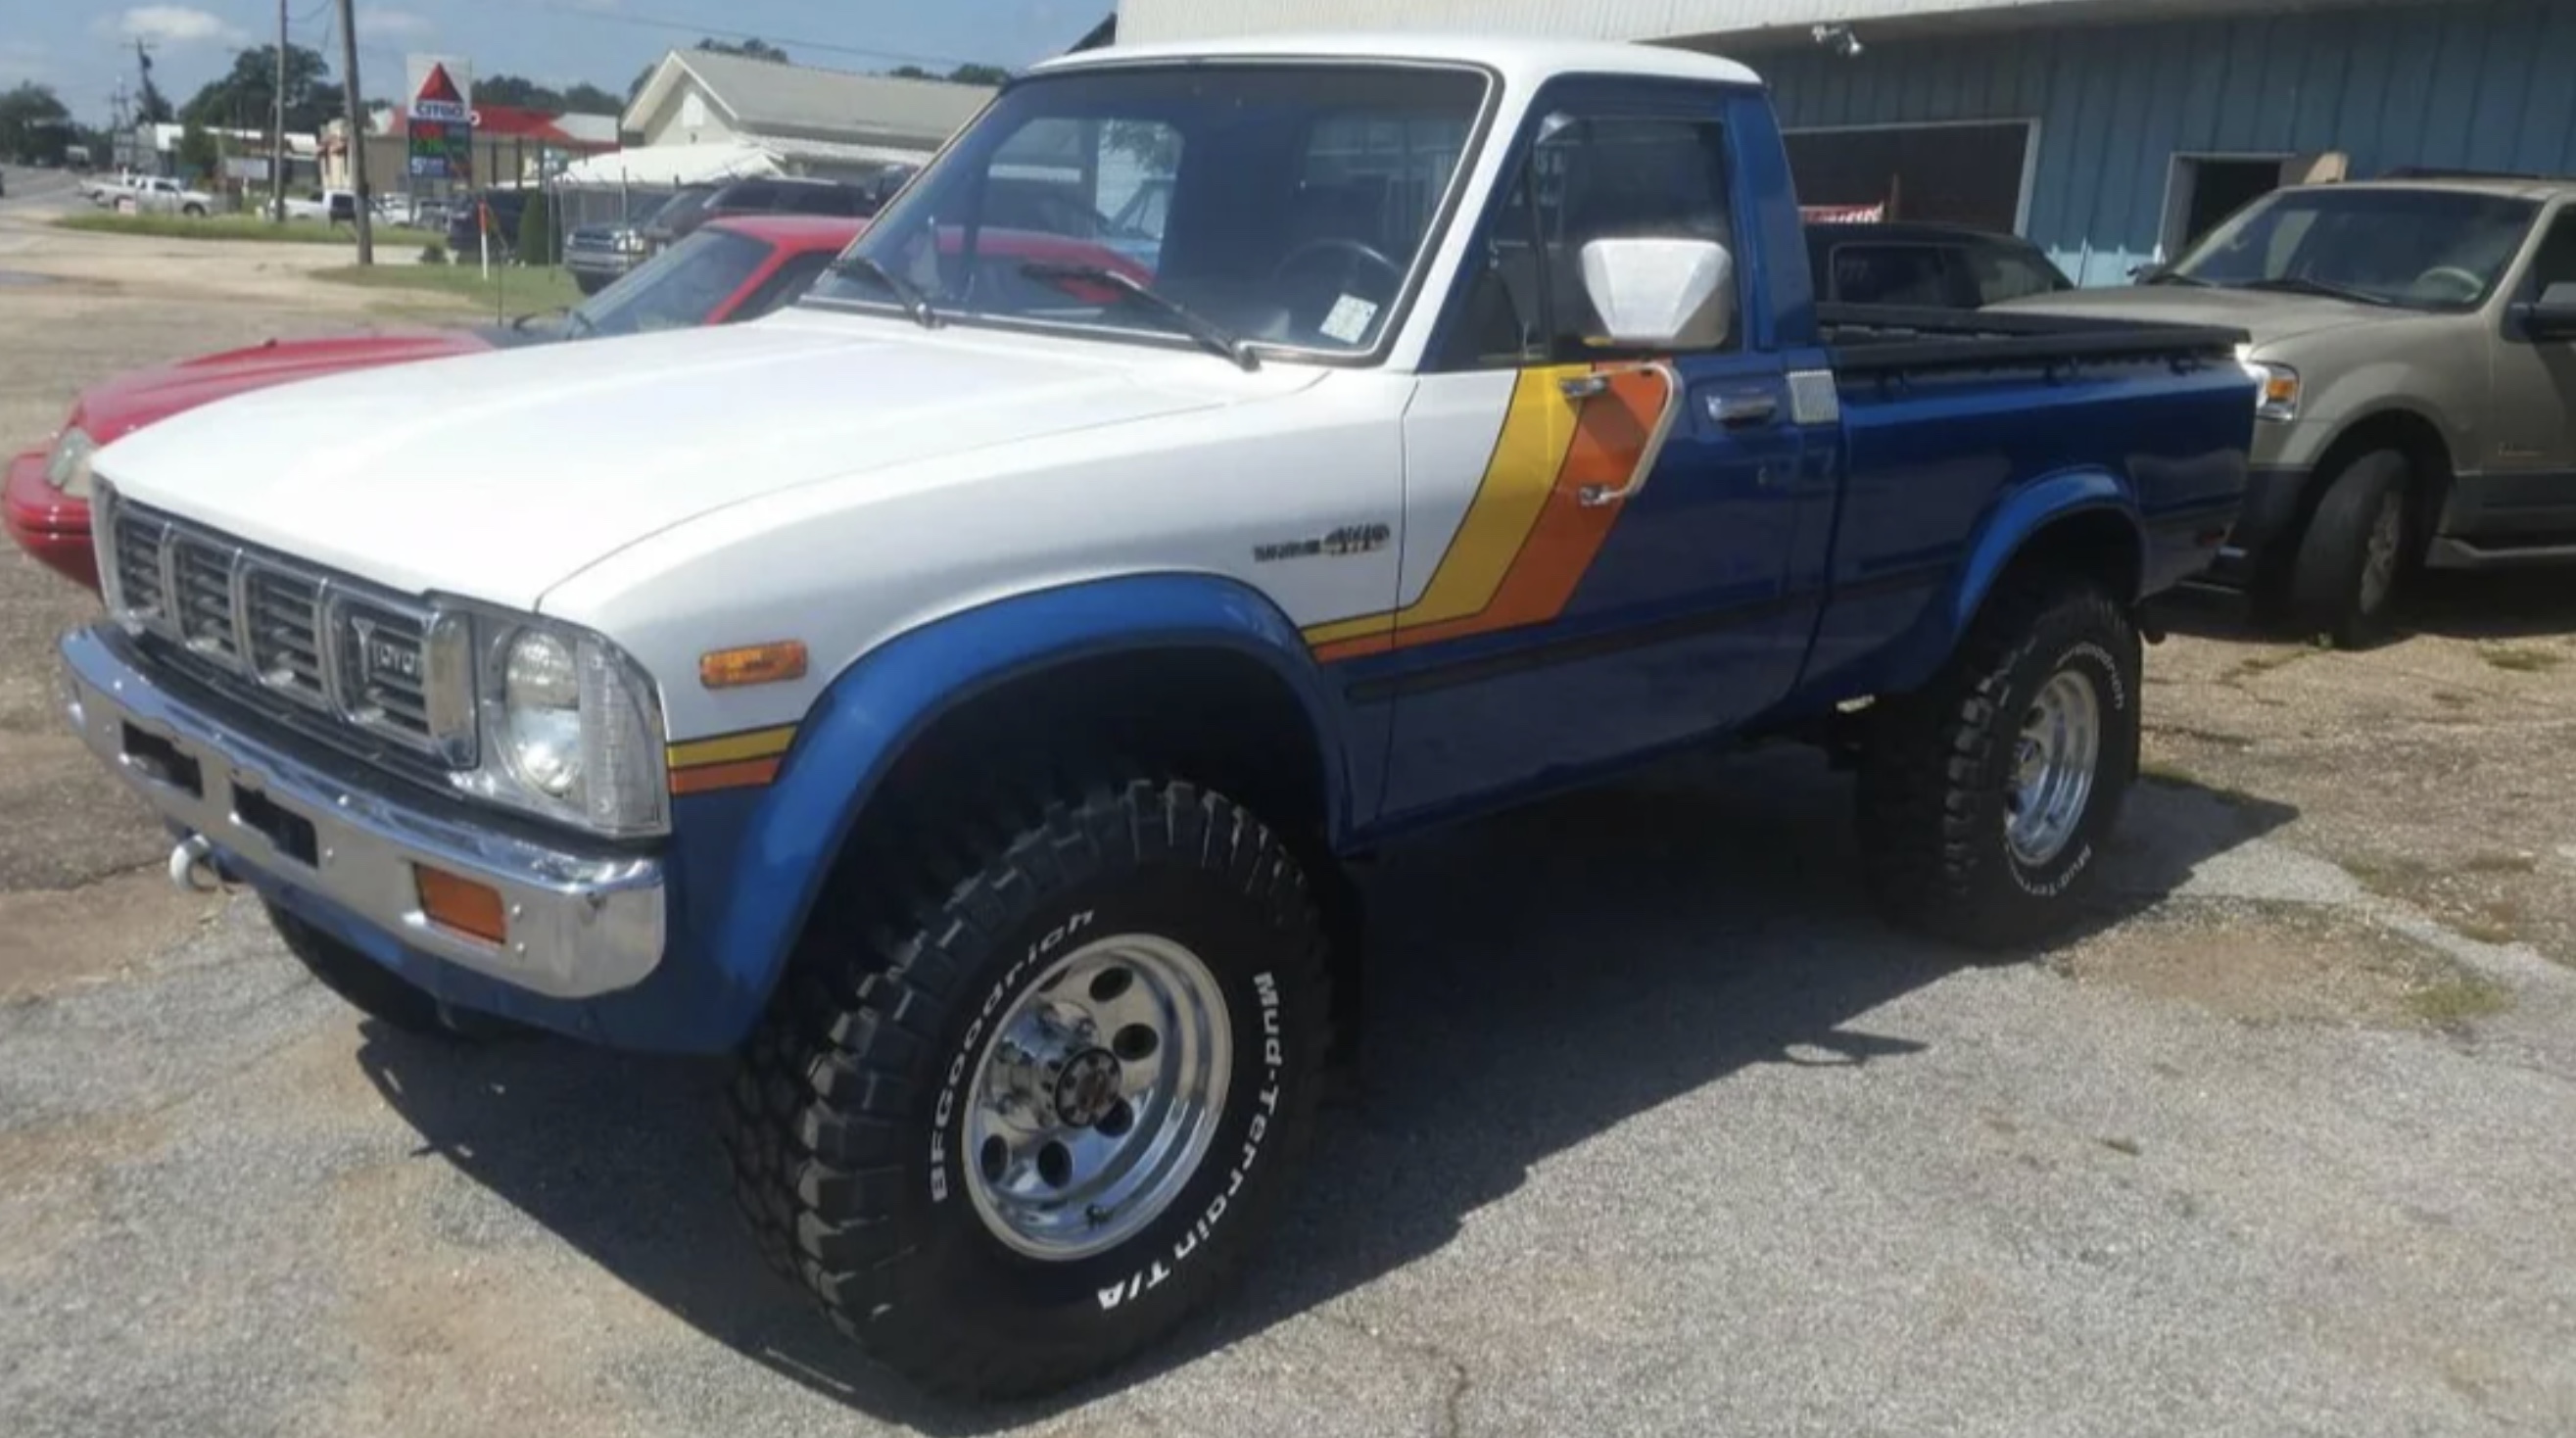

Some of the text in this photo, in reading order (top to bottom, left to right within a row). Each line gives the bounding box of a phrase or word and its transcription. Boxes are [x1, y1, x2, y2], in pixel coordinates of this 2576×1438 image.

[930, 910, 1095, 1202] BFGoodrich
[1098, 972, 1283, 1310] Mud-Terrain T/A
